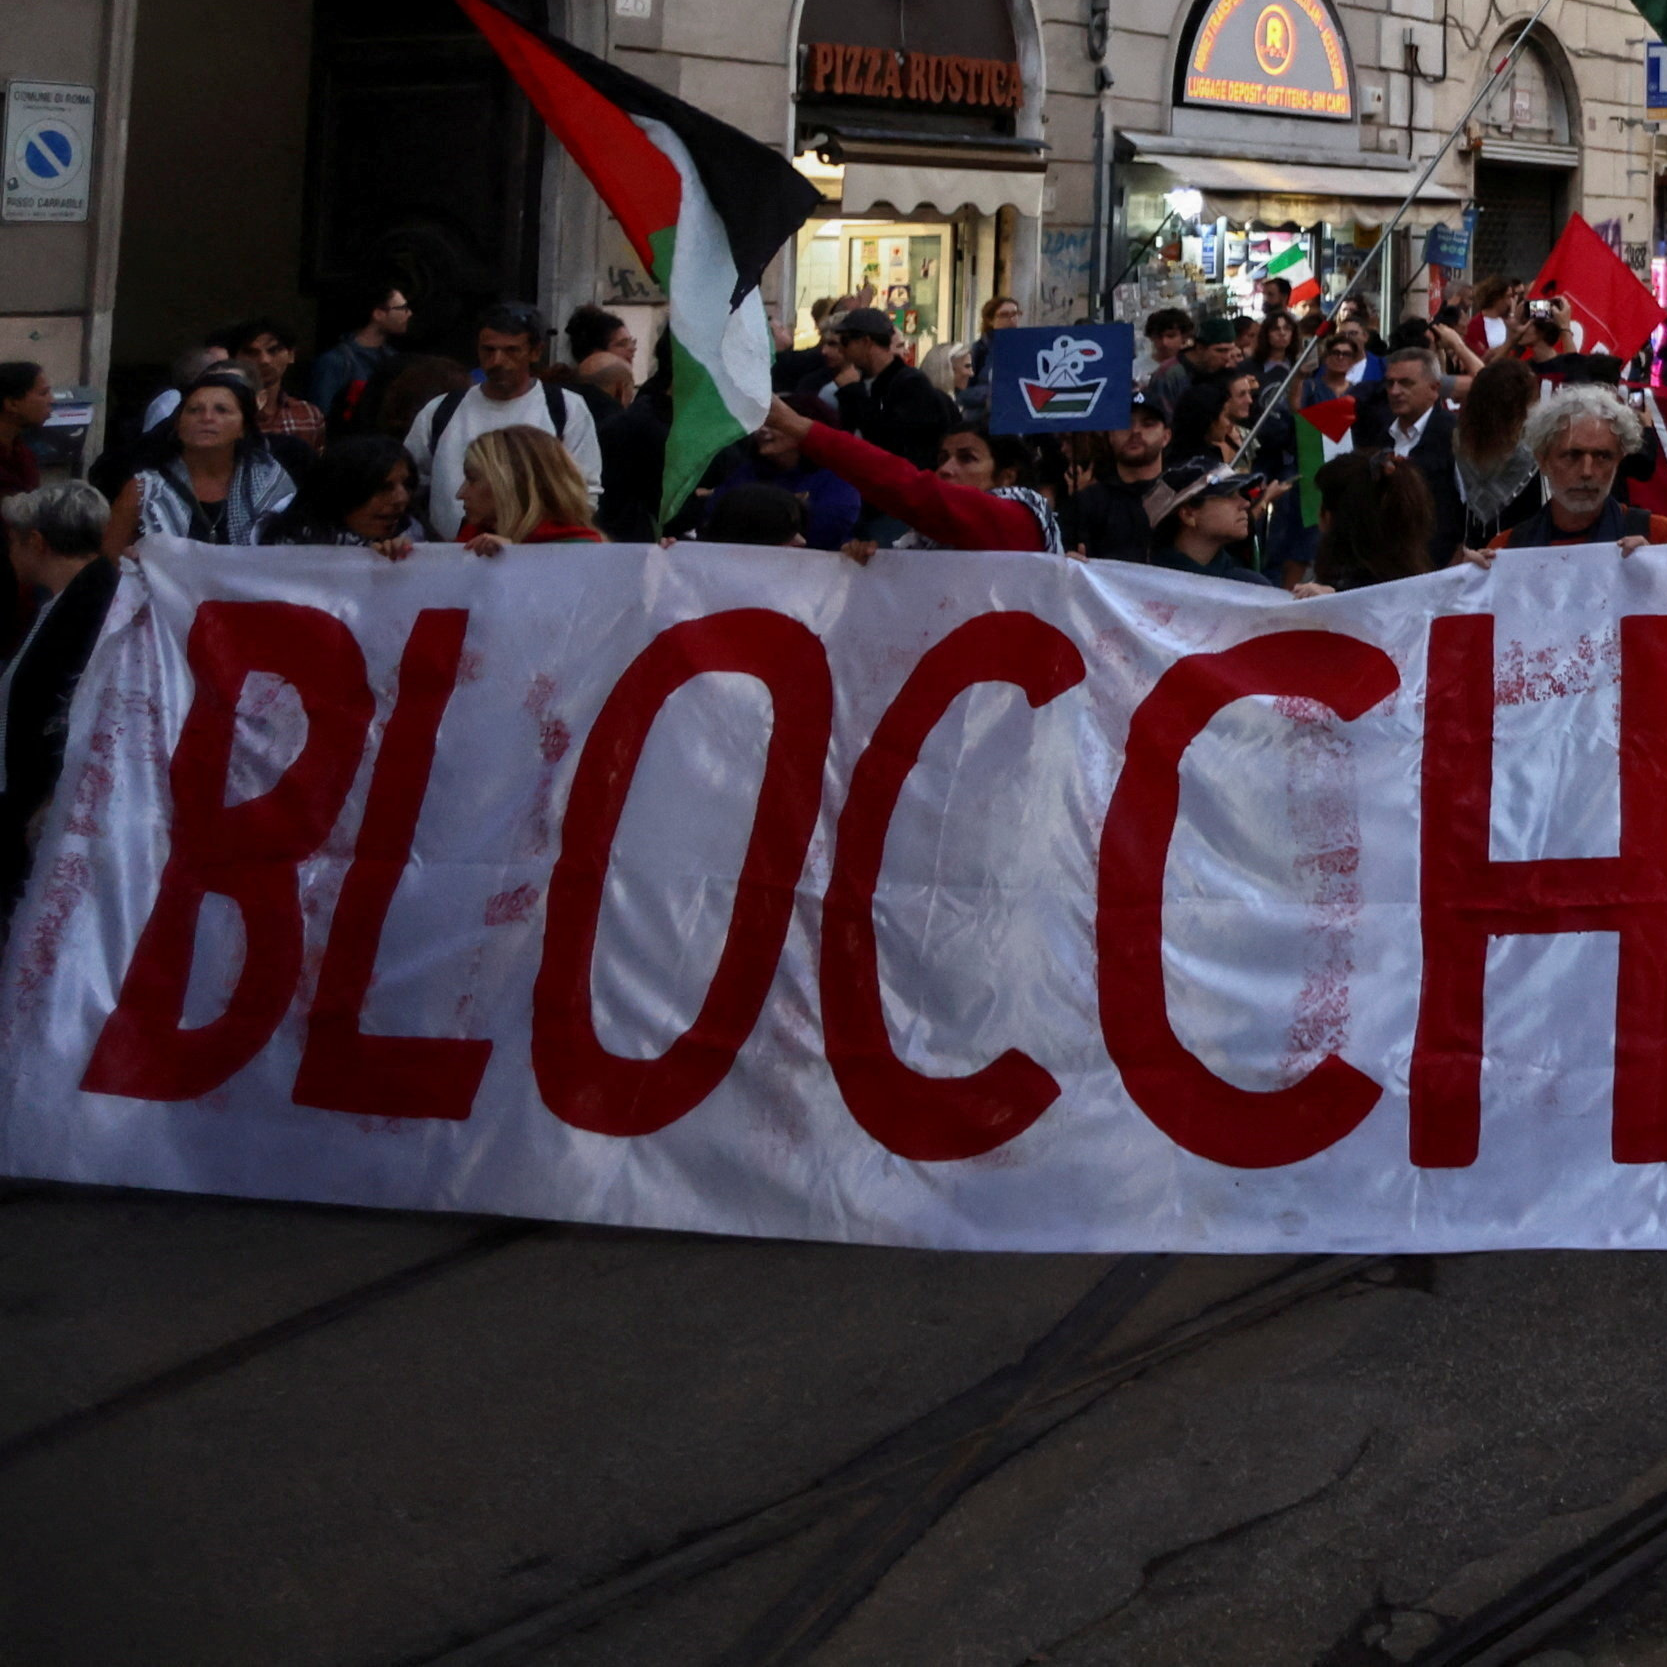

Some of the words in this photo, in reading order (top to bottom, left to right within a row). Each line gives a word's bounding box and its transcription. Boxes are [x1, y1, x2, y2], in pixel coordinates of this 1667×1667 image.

[813, 42, 901, 99] PIZZA
[906, 51, 1024, 109] RUSTICA
[1187, 76, 1228, 99] LUGGAGE
[1228, 80, 1264, 104] DEPOSIT
